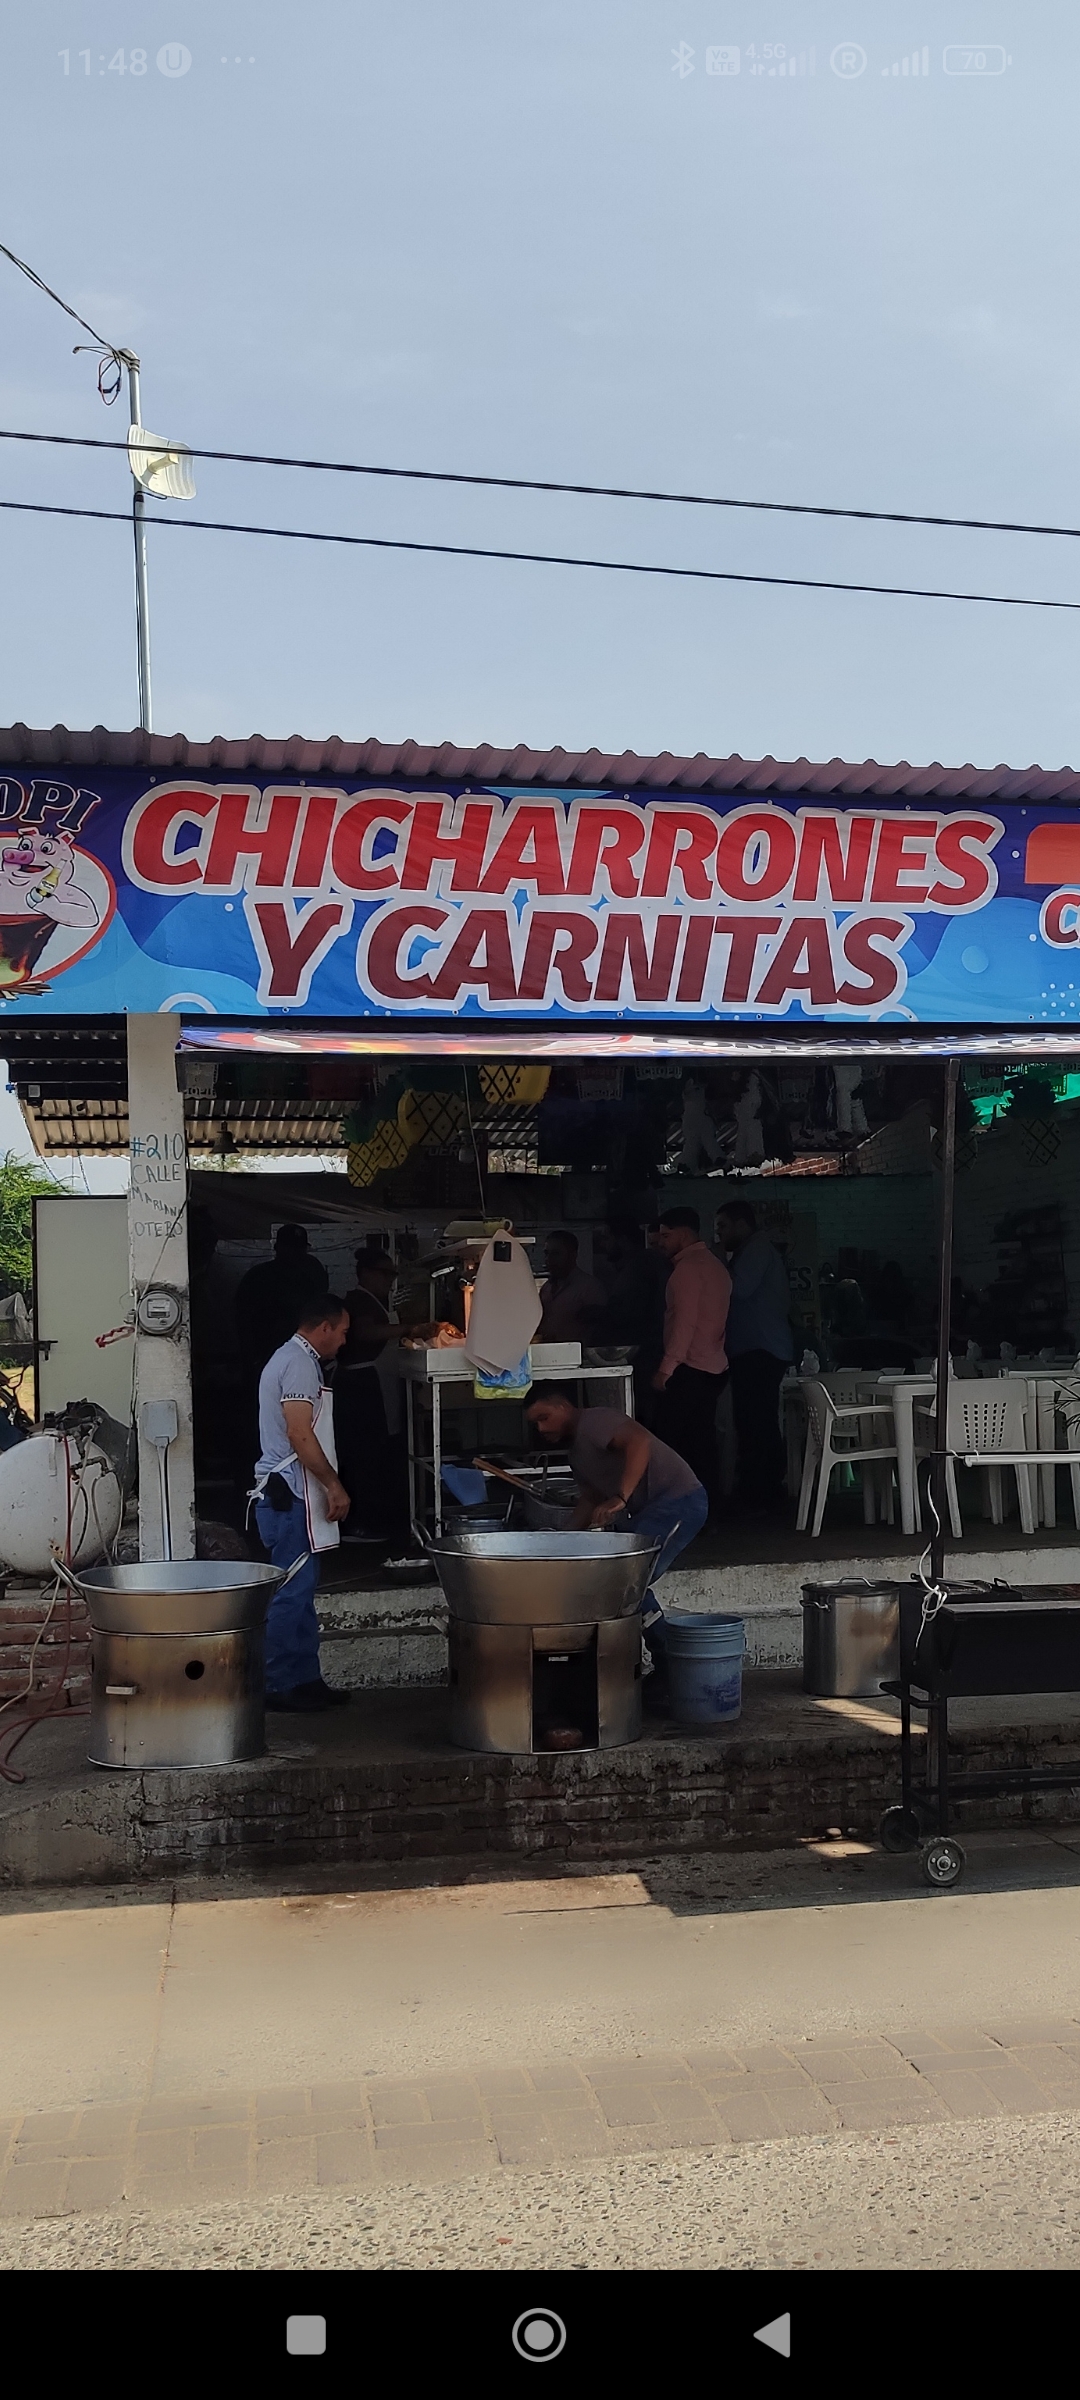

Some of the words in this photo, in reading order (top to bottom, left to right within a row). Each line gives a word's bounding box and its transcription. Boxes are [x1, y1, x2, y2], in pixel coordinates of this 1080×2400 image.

[130, 788, 998, 907] CHICHARRONES
[1043, 891, 1080, 946] C
[252, 901, 345, 999] Y
[365, 903, 906, 1007] CARNITAS
[130, 1133, 185, 1161] #210
[132, 1163, 182, 1185] CALLE
